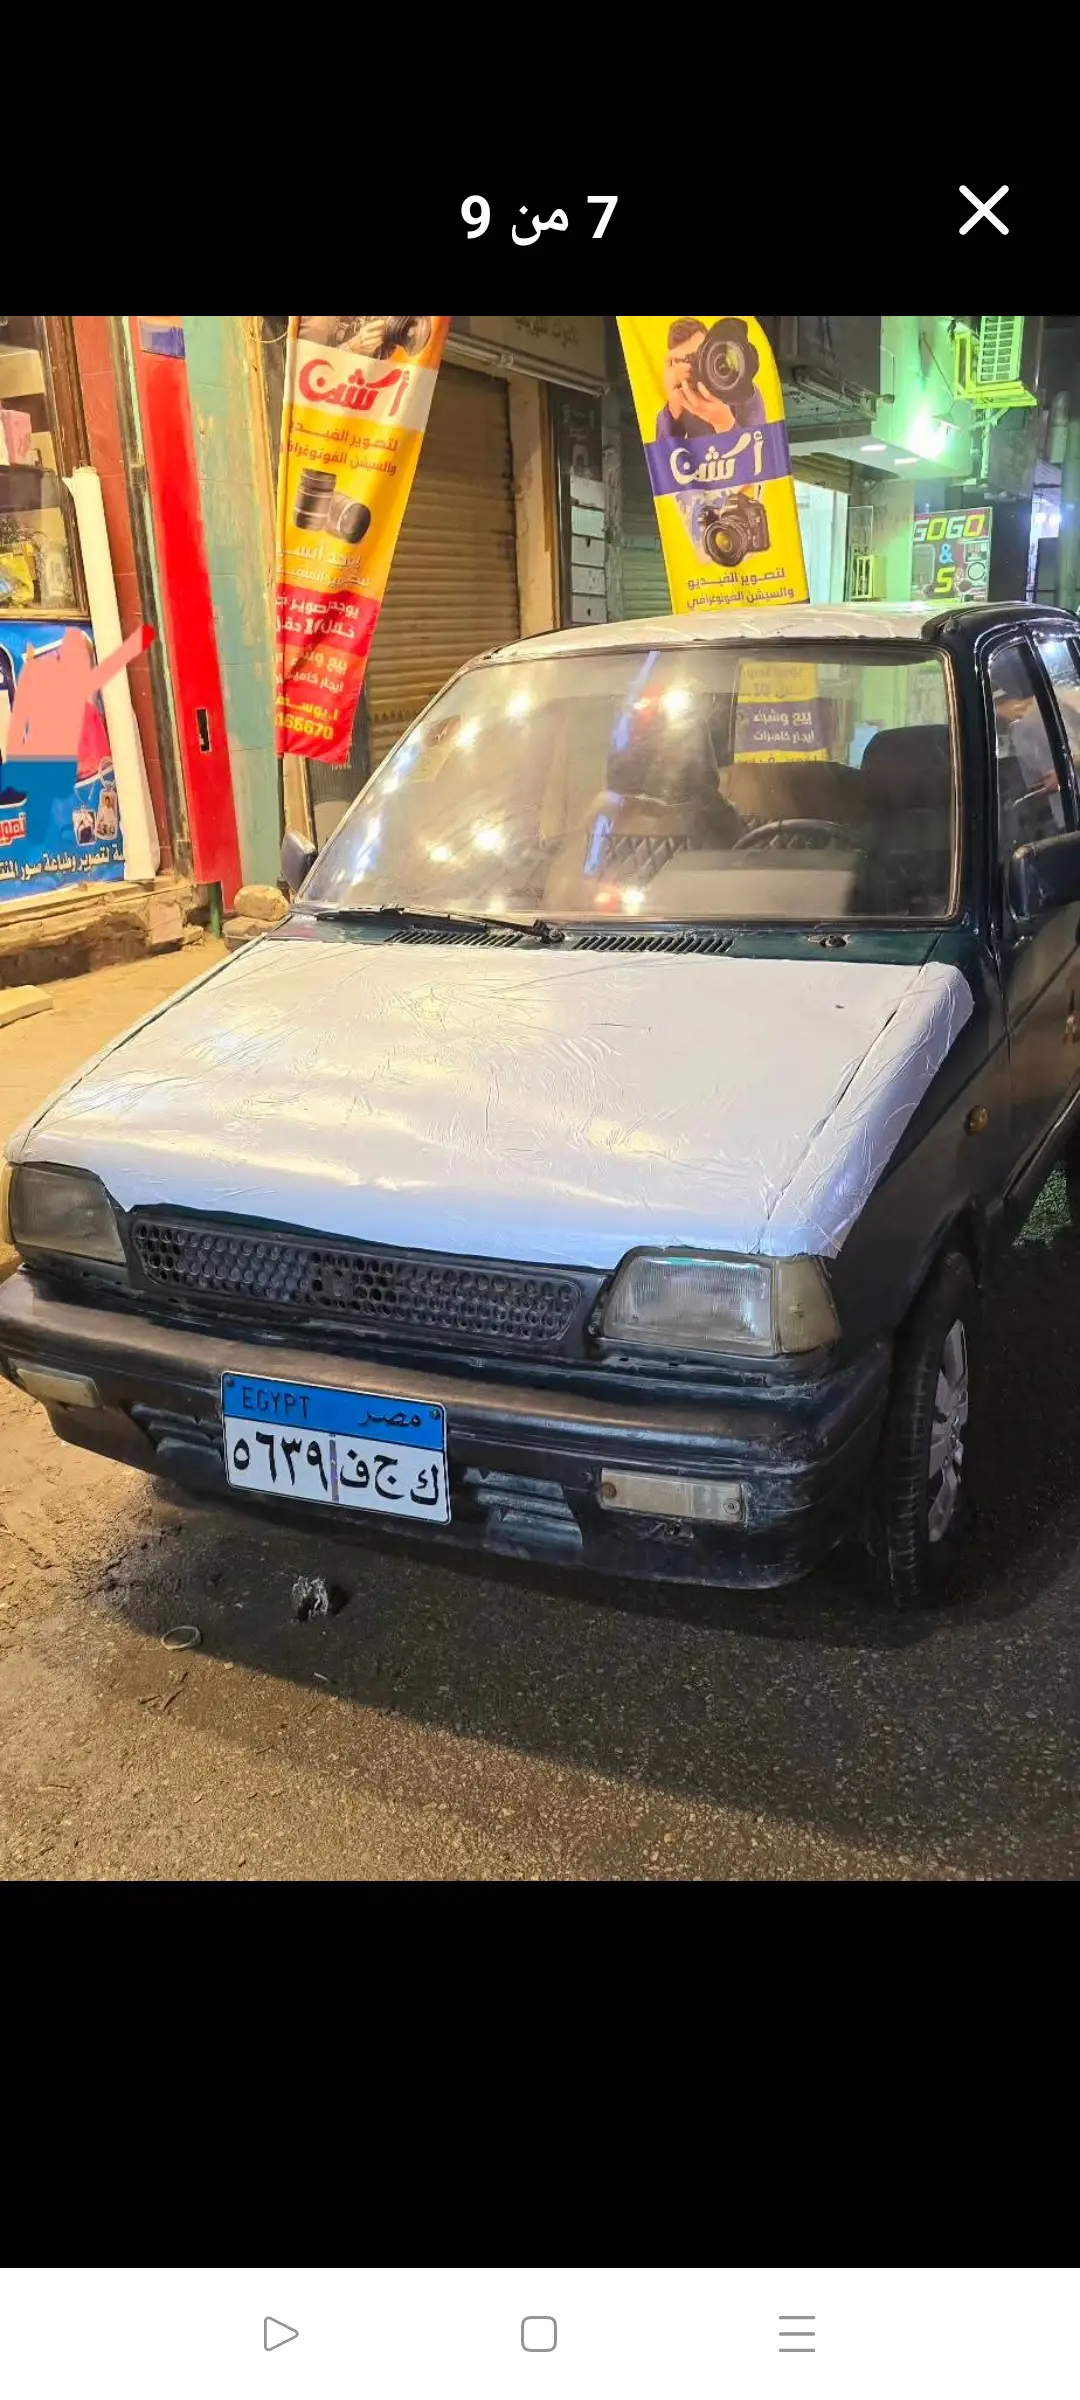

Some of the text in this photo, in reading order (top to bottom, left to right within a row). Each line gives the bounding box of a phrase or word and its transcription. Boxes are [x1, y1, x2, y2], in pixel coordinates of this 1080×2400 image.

[298, 358, 411, 417] أكشن
[669, 430, 765, 485] أكشن
[938, 542, 954, 564] &
[686, 566, 786, 591] لتصوير الفيديو
[745, 586, 795, 604] والسيشن
[241, 1385, 311, 1420] EGYPT
[358, 1409, 423, 1428] مصر
[232, 1430, 329, 1493] ٥٦٣٩
